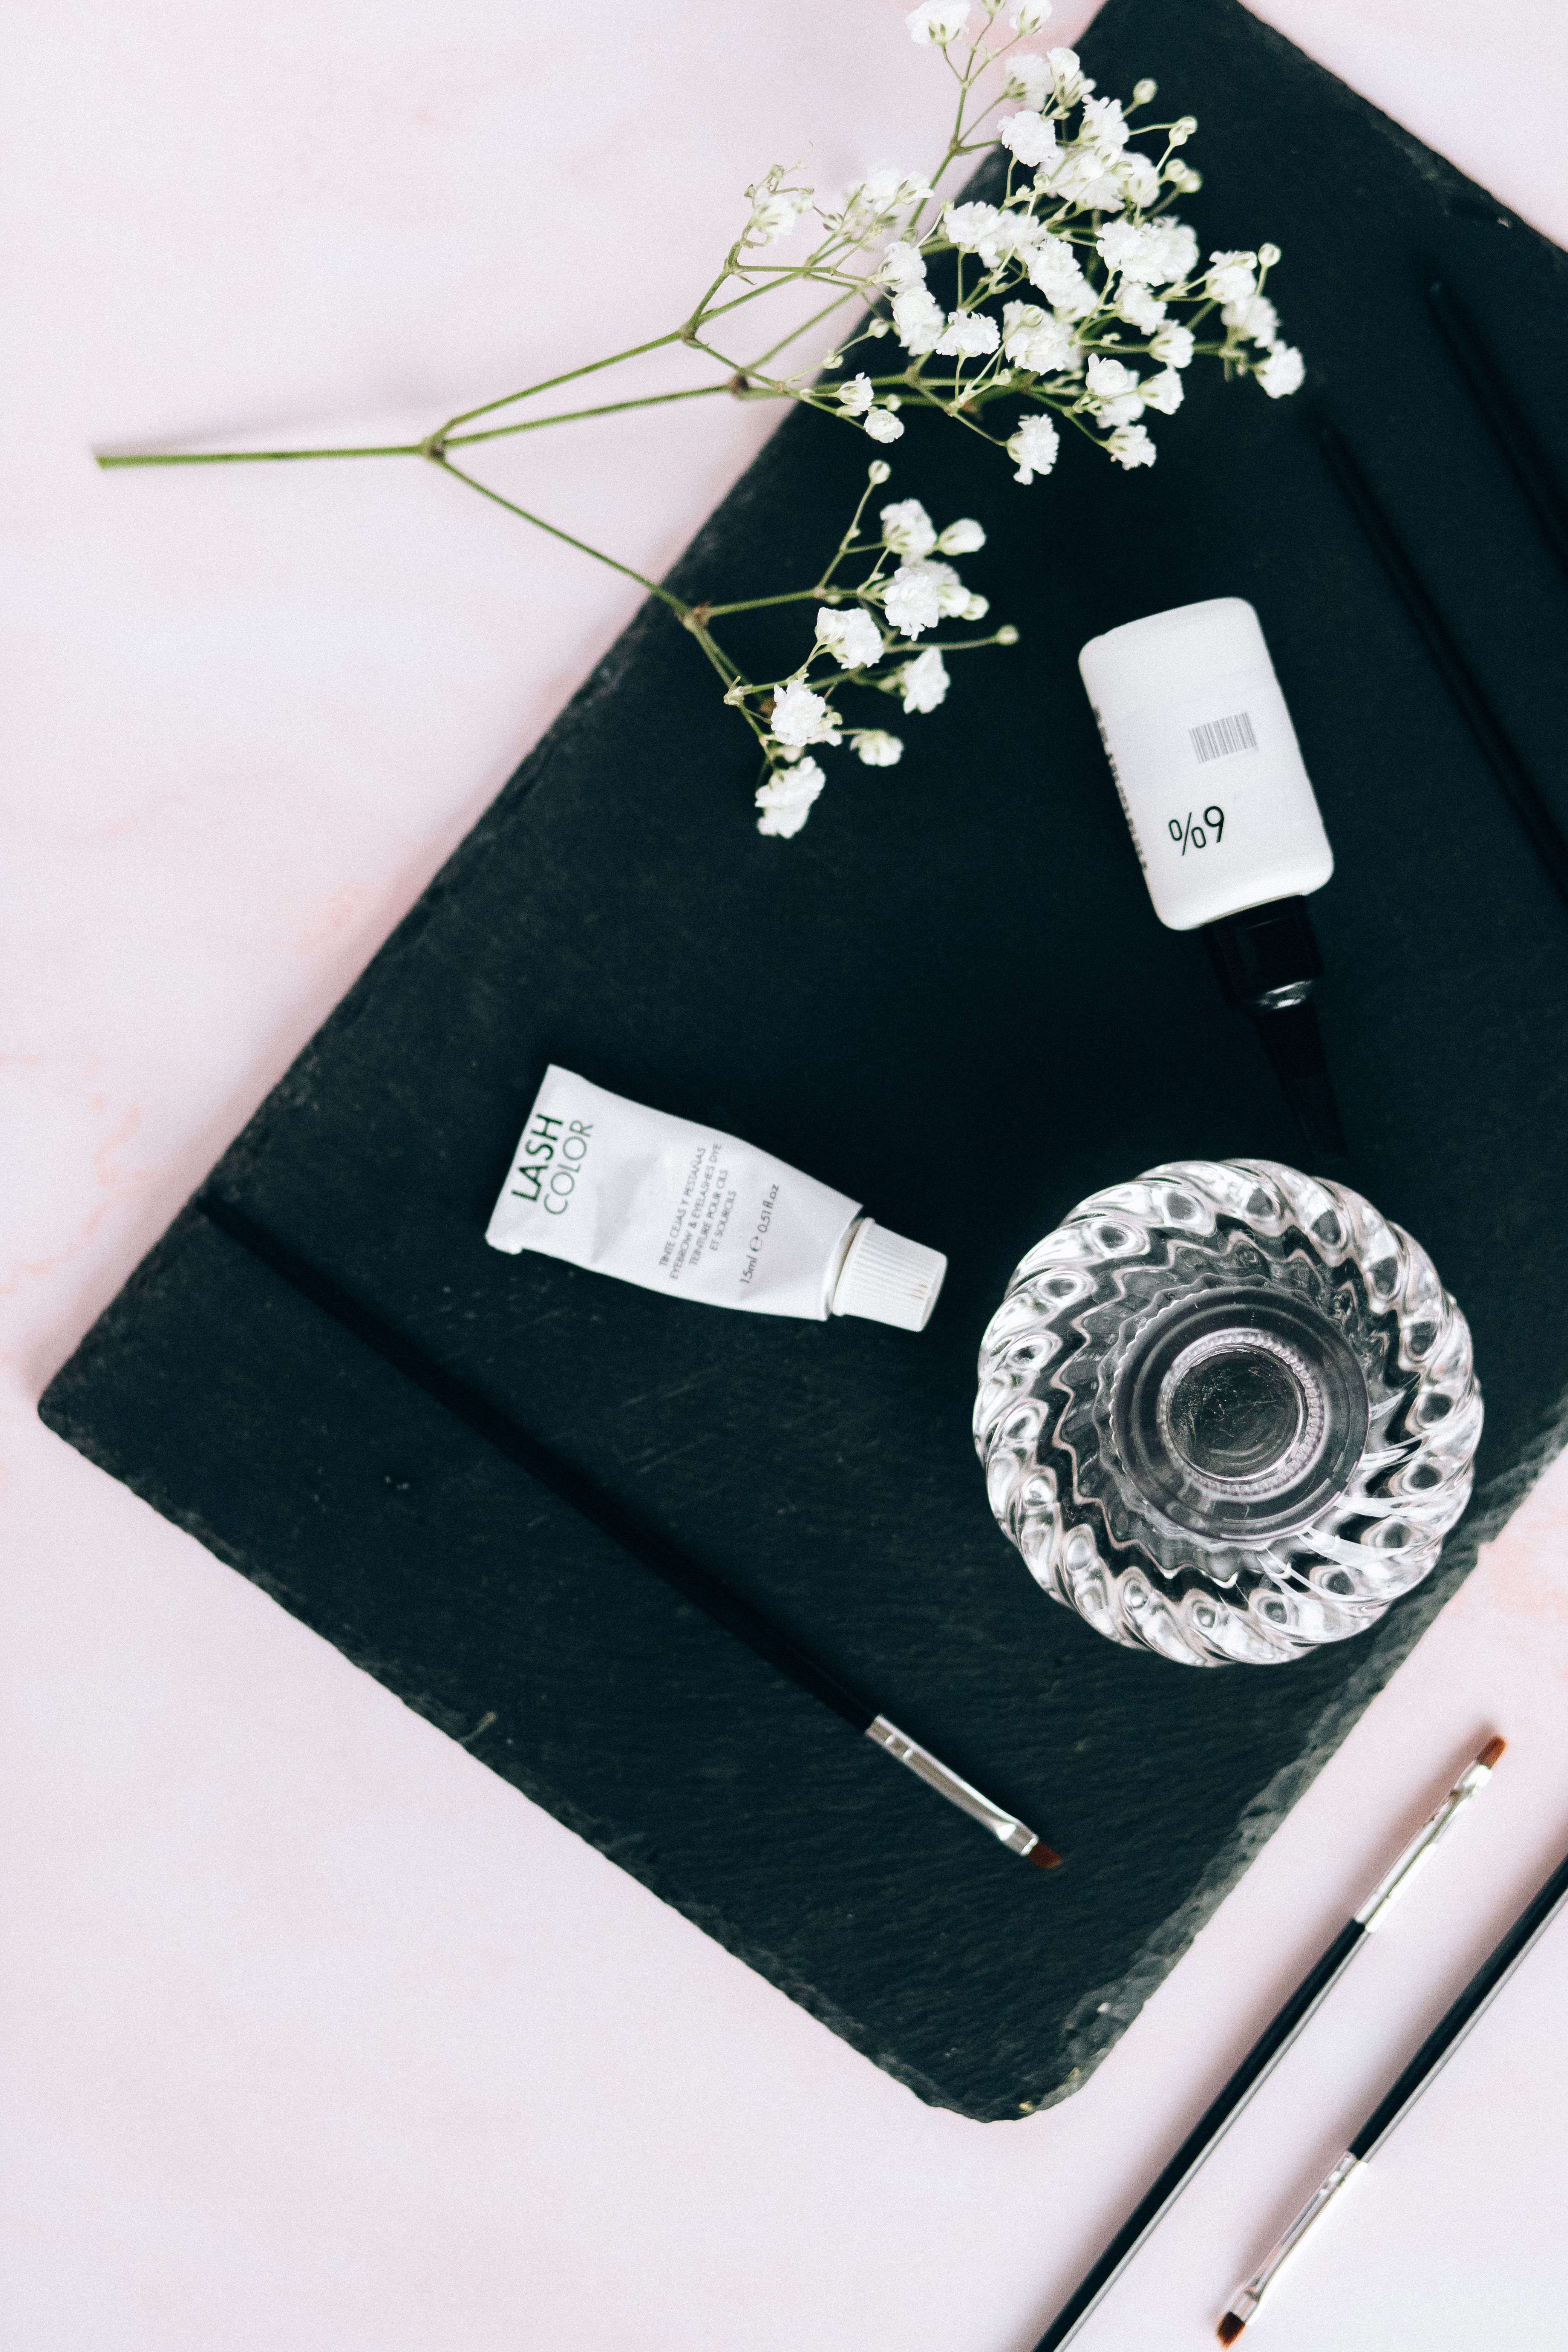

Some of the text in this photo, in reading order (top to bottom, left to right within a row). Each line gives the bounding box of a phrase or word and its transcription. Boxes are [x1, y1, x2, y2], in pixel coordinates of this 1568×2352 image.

[511, 1113, 563, 1202] LASH
[544, 1120, 593, 1215] COLOR
[658, 1241, 675, 1266] TINTE
[669, 1208, 687, 1239] CEJAS
[683, 1147, 706, 1197] PESTAÑAS
[669, 1230, 693, 1280] EYEBROW
[691, 1165, 715, 1219] EYELASHES
[708, 1143, 722, 1164] DYE
[688, 1169, 729, 1265] TEINTURE POUR CILS
[709, 1191, 737, 1252] ET SOURCILS
[739, 1254, 758, 1284] 15ml
